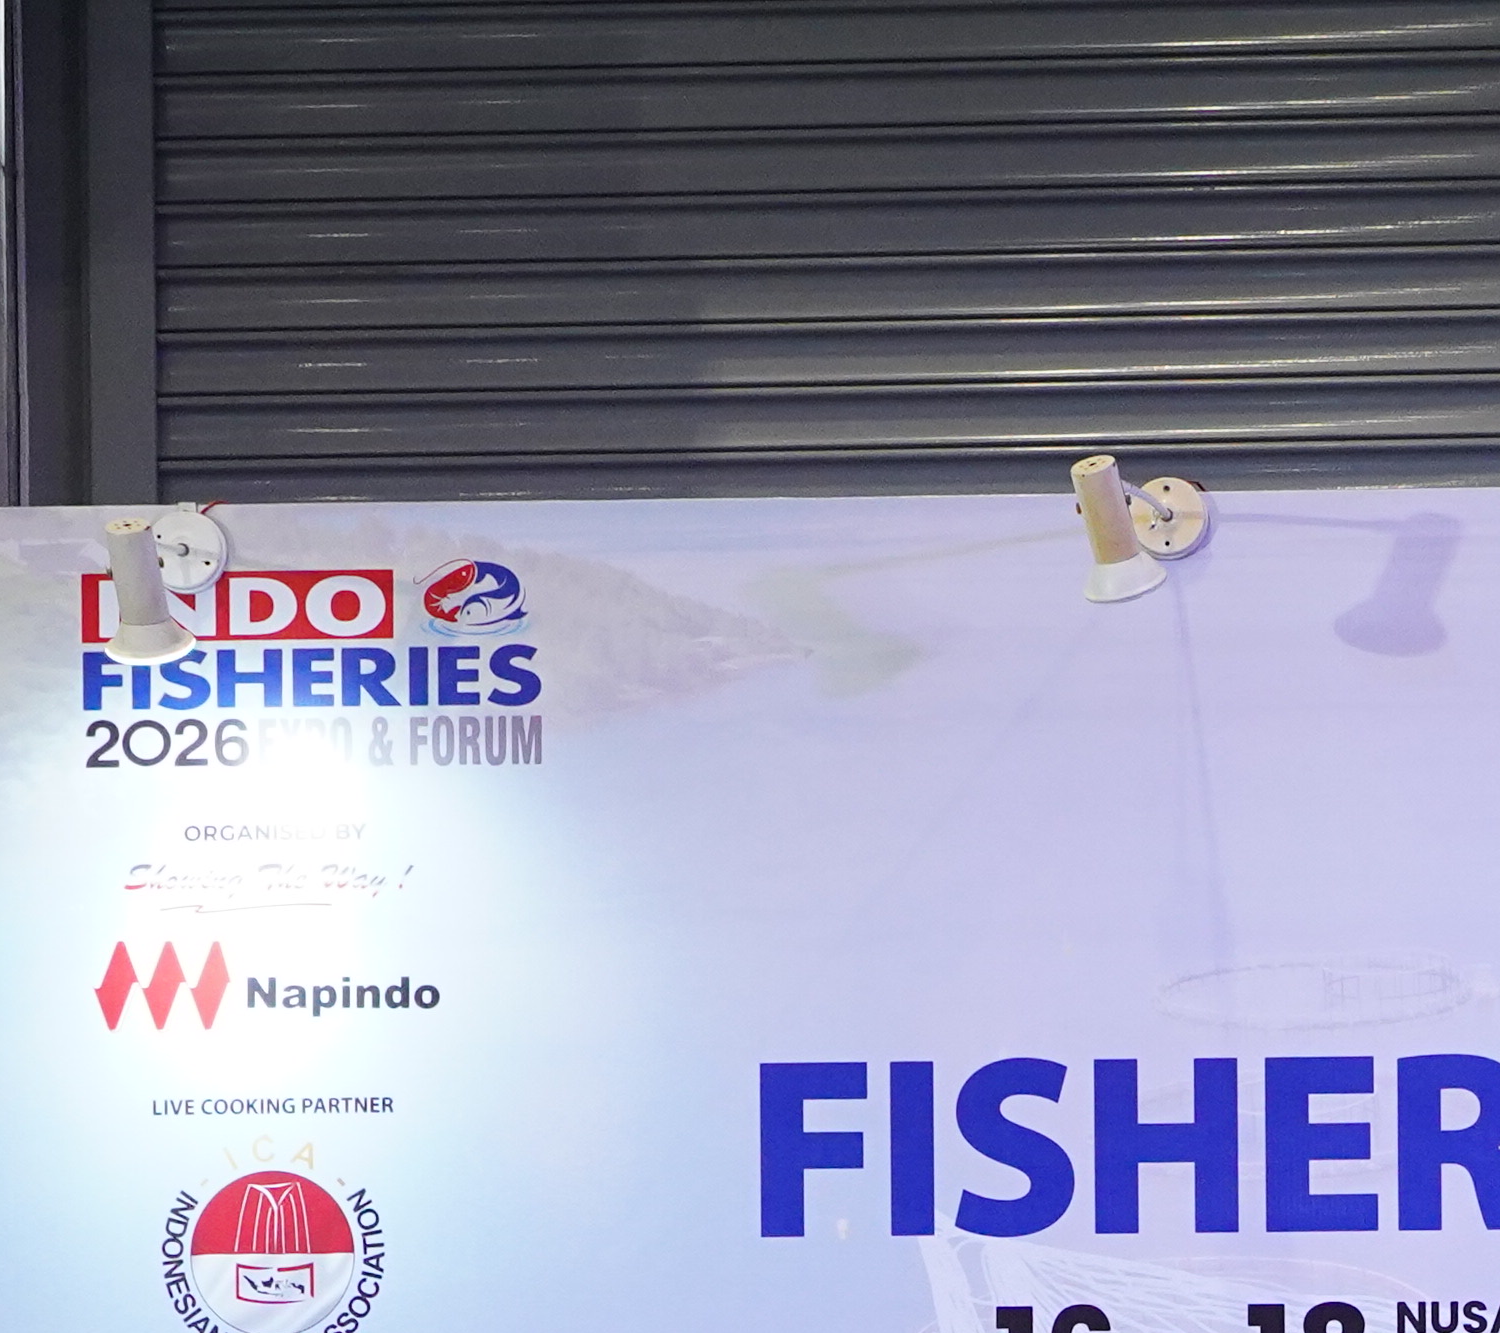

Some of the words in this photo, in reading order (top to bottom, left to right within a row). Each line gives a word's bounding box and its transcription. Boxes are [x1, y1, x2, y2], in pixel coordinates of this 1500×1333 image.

[82, 644, 542, 711] FISHERIES
[86, 718, 248, 768] 2026
[368, 717, 394, 766] &
[409, 715, 543, 766] FORUM
[336, 824, 366, 841] BY
[246, 977, 441, 1017] Napindo
[152, 1099, 195, 1116] LIVE
[201, 1098, 296, 1115] COOKING
[302, 1097, 395, 1114] PARTNER
